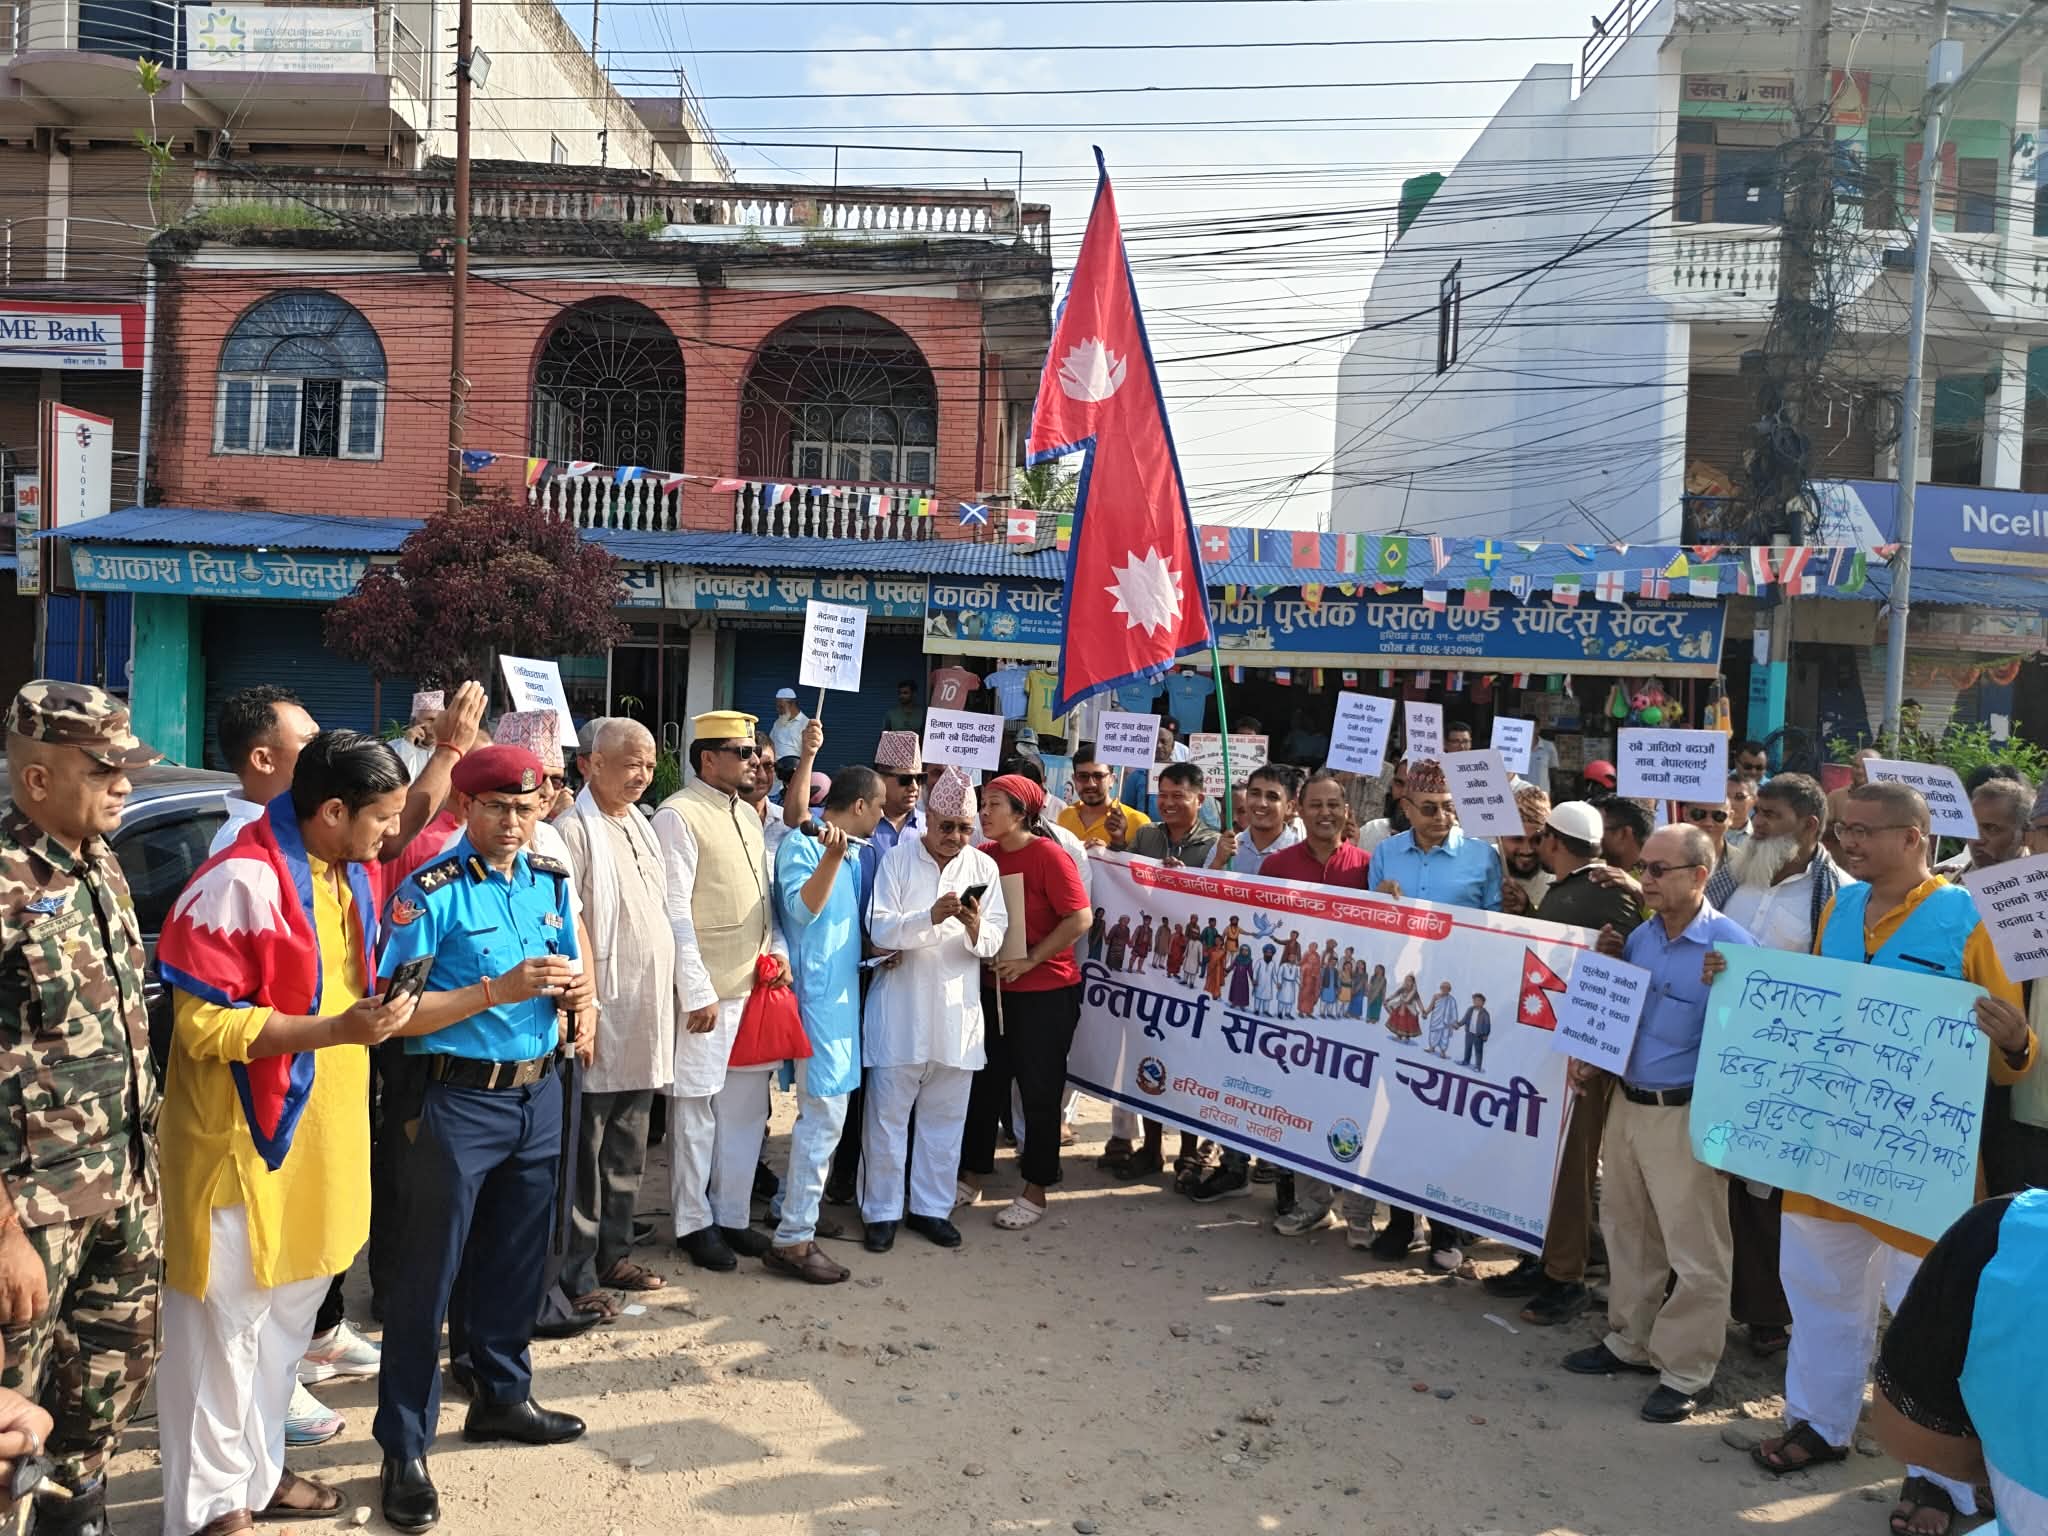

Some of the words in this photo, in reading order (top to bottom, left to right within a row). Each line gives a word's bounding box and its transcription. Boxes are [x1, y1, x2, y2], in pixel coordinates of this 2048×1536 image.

[48, 320, 106, 343] Bank
[1962, 504, 2048, 537] Ncell
[95, 554, 182, 584] आकाश
[188, 550, 238, 587] दिप
[264, 553, 349, 591] ज्वेलर्स
[776, 576, 814, 603] सुन
[875, 580, 928, 606] पसल
[934, 581, 1000, 610] कार्की
[1007, 583, 1064, 618] स्पोर्ट्
[1274, 599, 1359, 634] पुस्तक
[1367, 602, 1435, 631] पसल
[1447, 605, 1504, 632] एण्ड
[1512, 600, 1602, 640] स्पोर्ट्स
[1608, 601, 1688, 639] सेन्टर
[940, 685, 957, 701] 10
[1628, 740, 1643, 752] सबै
[1647, 740, 1681, 753] जातिको
[1660, 756, 1708, 771] नेपाललाई
[1927, 775, 1954, 788] नेपाल
[1223, 883, 1250, 899] तथा
[1255, 889, 1327, 912] सामाजिक
[1331, 900, 1404, 926] एकताको
[1407, 912, 1447, 934] लागि
[1992, 893, 2030, 912] फूलको
[2036, 911, 2046, 920] र
[1079, 961, 1211, 1041] न्तिपूर्ण
[1220, 1010, 1379, 1089] सद्भाव
[1222, 1074, 1273, 1100] आयोजक
[1172, 1076, 1219, 1102] हरिवन
[1224, 1093, 1313, 1133] नगरपालिका
[1246, 1118, 1284, 1143] सर्लाही
[1873, 1124, 1932, 1166] दिदी
